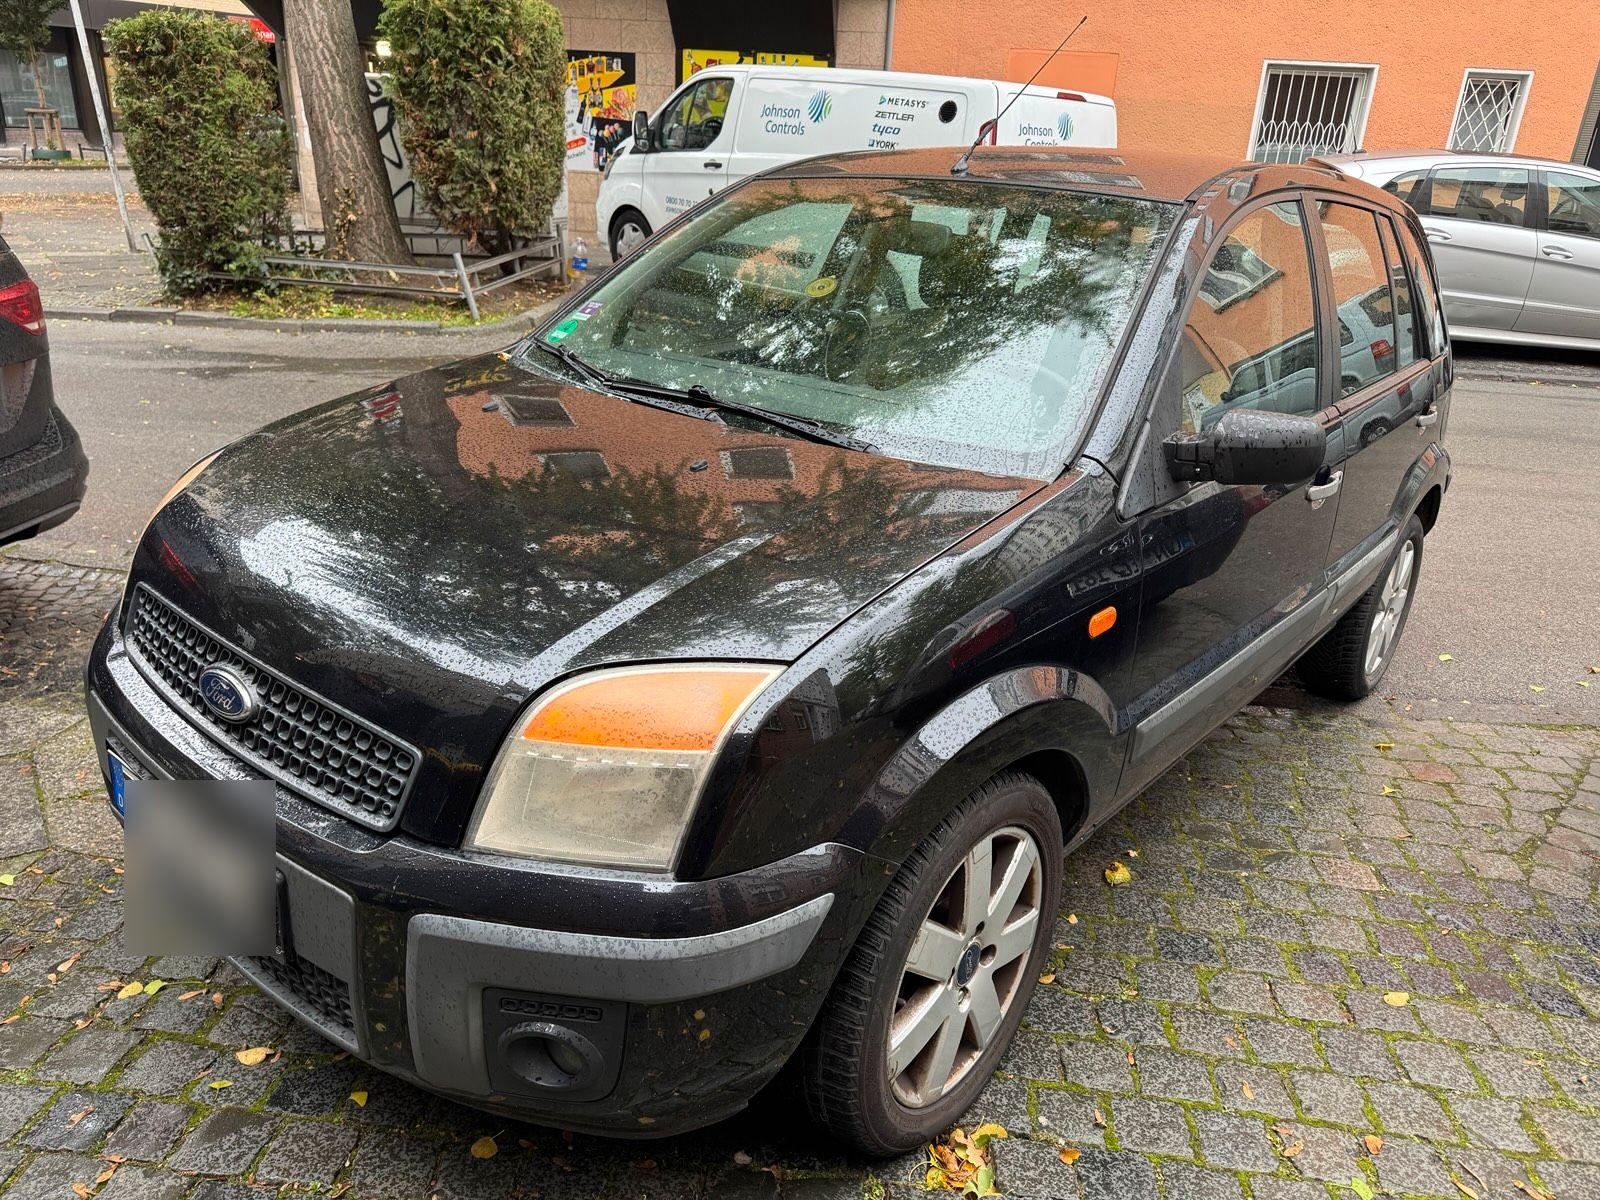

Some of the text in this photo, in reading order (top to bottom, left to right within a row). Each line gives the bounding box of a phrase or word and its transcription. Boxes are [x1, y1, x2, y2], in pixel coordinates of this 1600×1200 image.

[760, 104, 801, 119] Johnson
[875, 111, 915, 122] ZETTLER
[765, 120, 805, 136] Controls
[872, 123, 901, 136] tyco
[1018, 123, 1053, 137] Johnson
[876, 140, 896, 150] YORK
[206, 678, 236, 710] Ford
[118, 793, 124, 808] D
